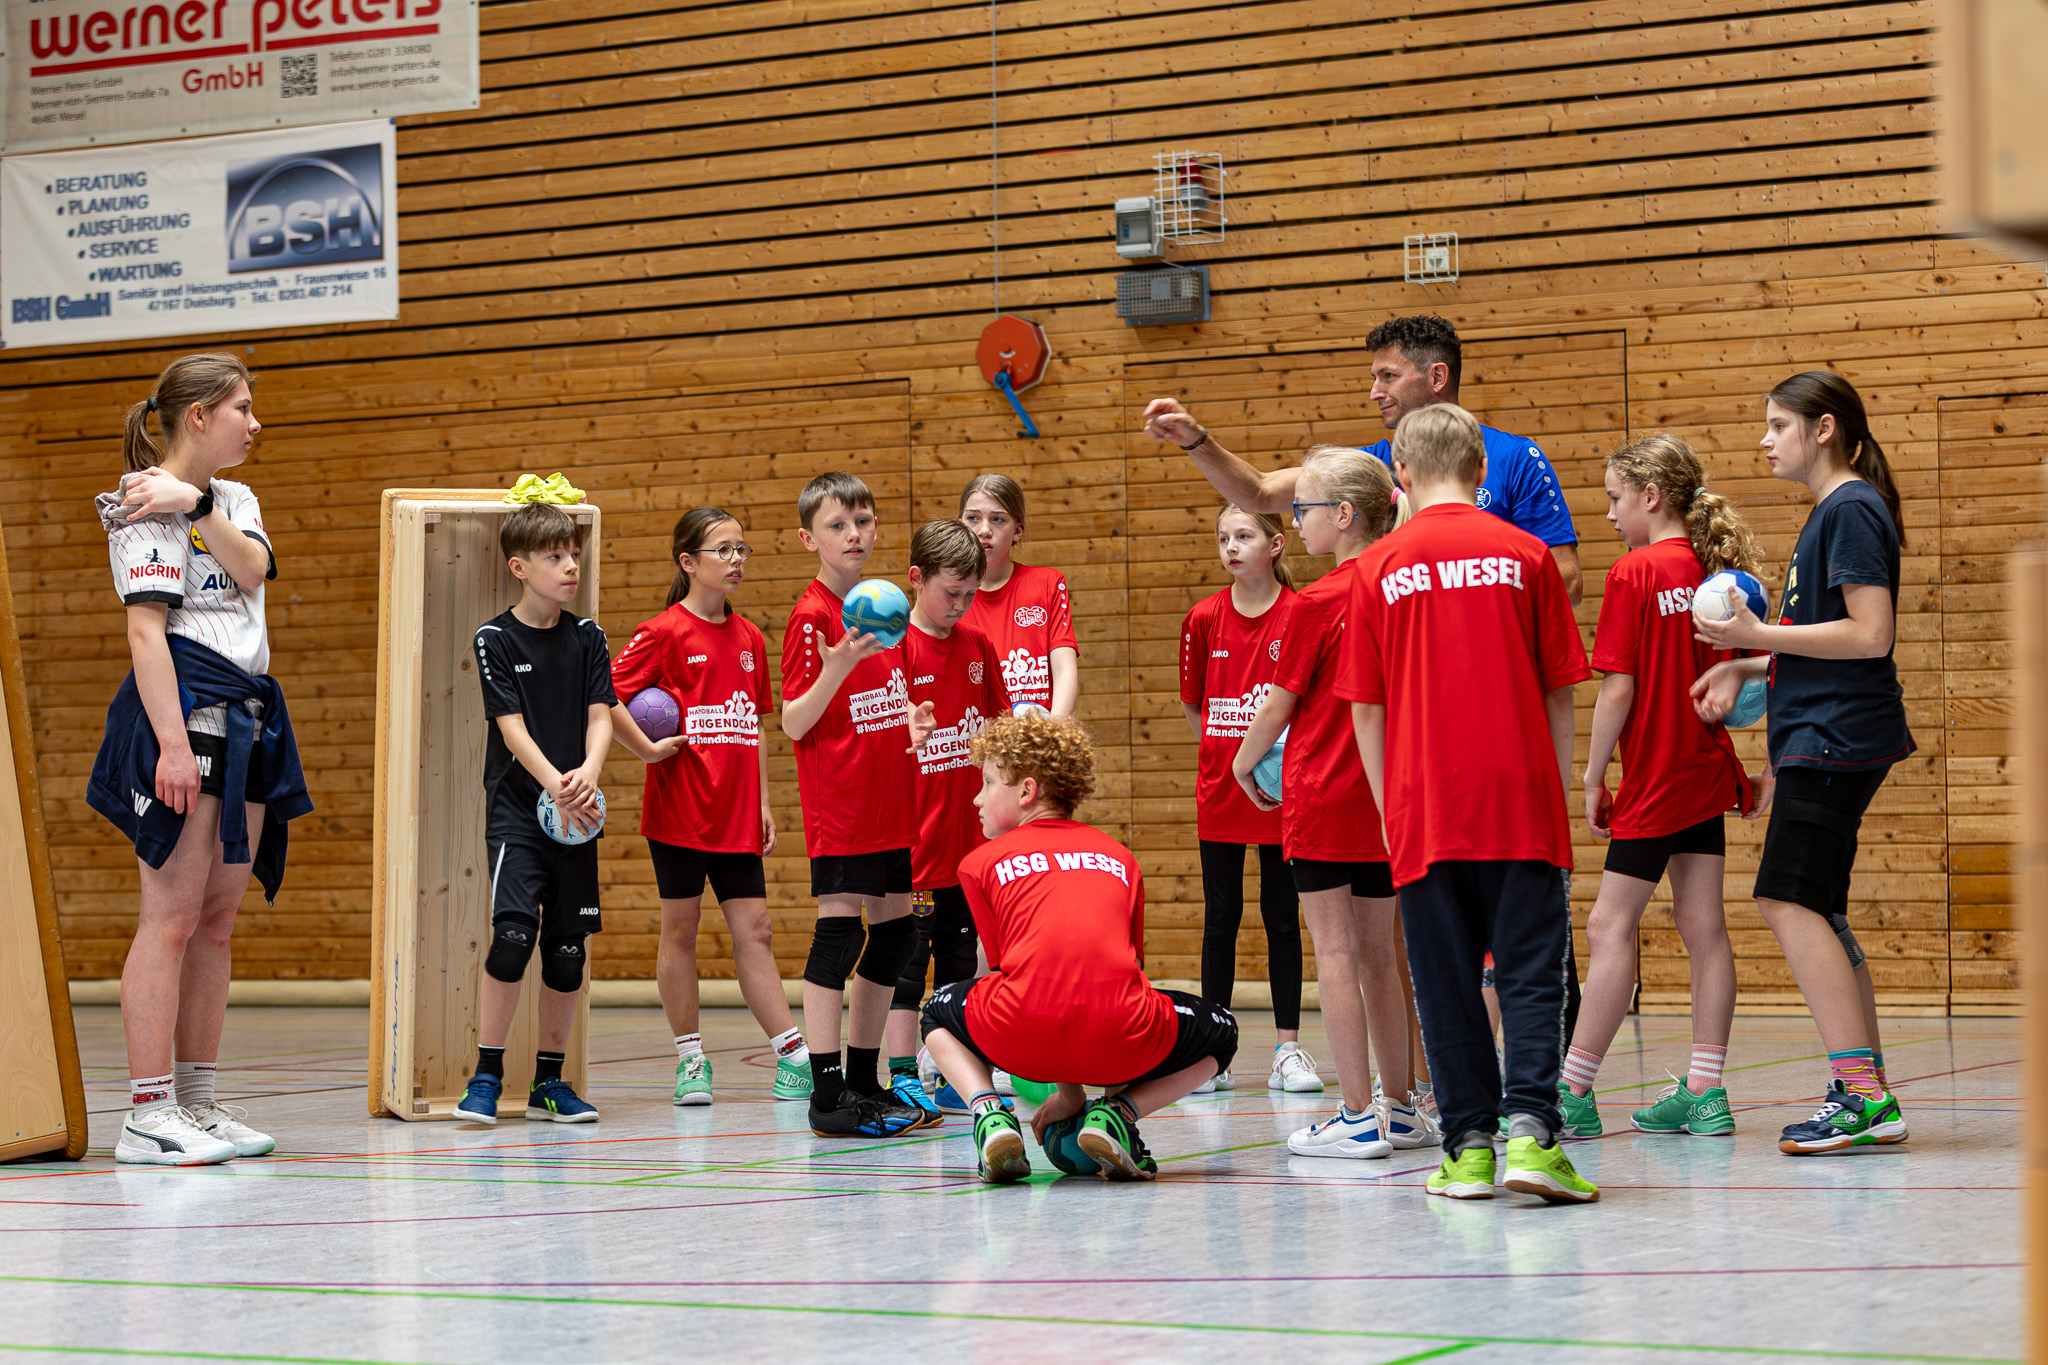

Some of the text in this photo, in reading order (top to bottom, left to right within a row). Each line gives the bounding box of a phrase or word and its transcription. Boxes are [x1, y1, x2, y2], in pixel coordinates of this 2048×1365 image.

[30, 0, 228, 59] werner
[182, 61, 264, 95] GmbH
[55, 171, 148, 194] BERATUNG
[68, 194, 150, 215] PLANUNG
[77, 213, 191, 238] AUSFÜHRUNG
[246, 196, 362, 257] BSH
[88, 238, 159, 259] SERVICE
[98, 261, 182, 283] WARTUNG
[373, 267, 387, 279] 16
[129, 564, 181, 580] NIGRIN
[1381, 557, 1524, 606] HSG WESEL
[686, 654, 708, 664] JAKO
[1211, 650, 1229, 658] JAKO
[514, 663, 532, 673] AKO
[913, 674, 935, 686] JAKO
[920, 757, 973, 776] #handba
[994, 851, 1129, 887] HSG WESEL
[579, 907, 599, 916] JAKO
